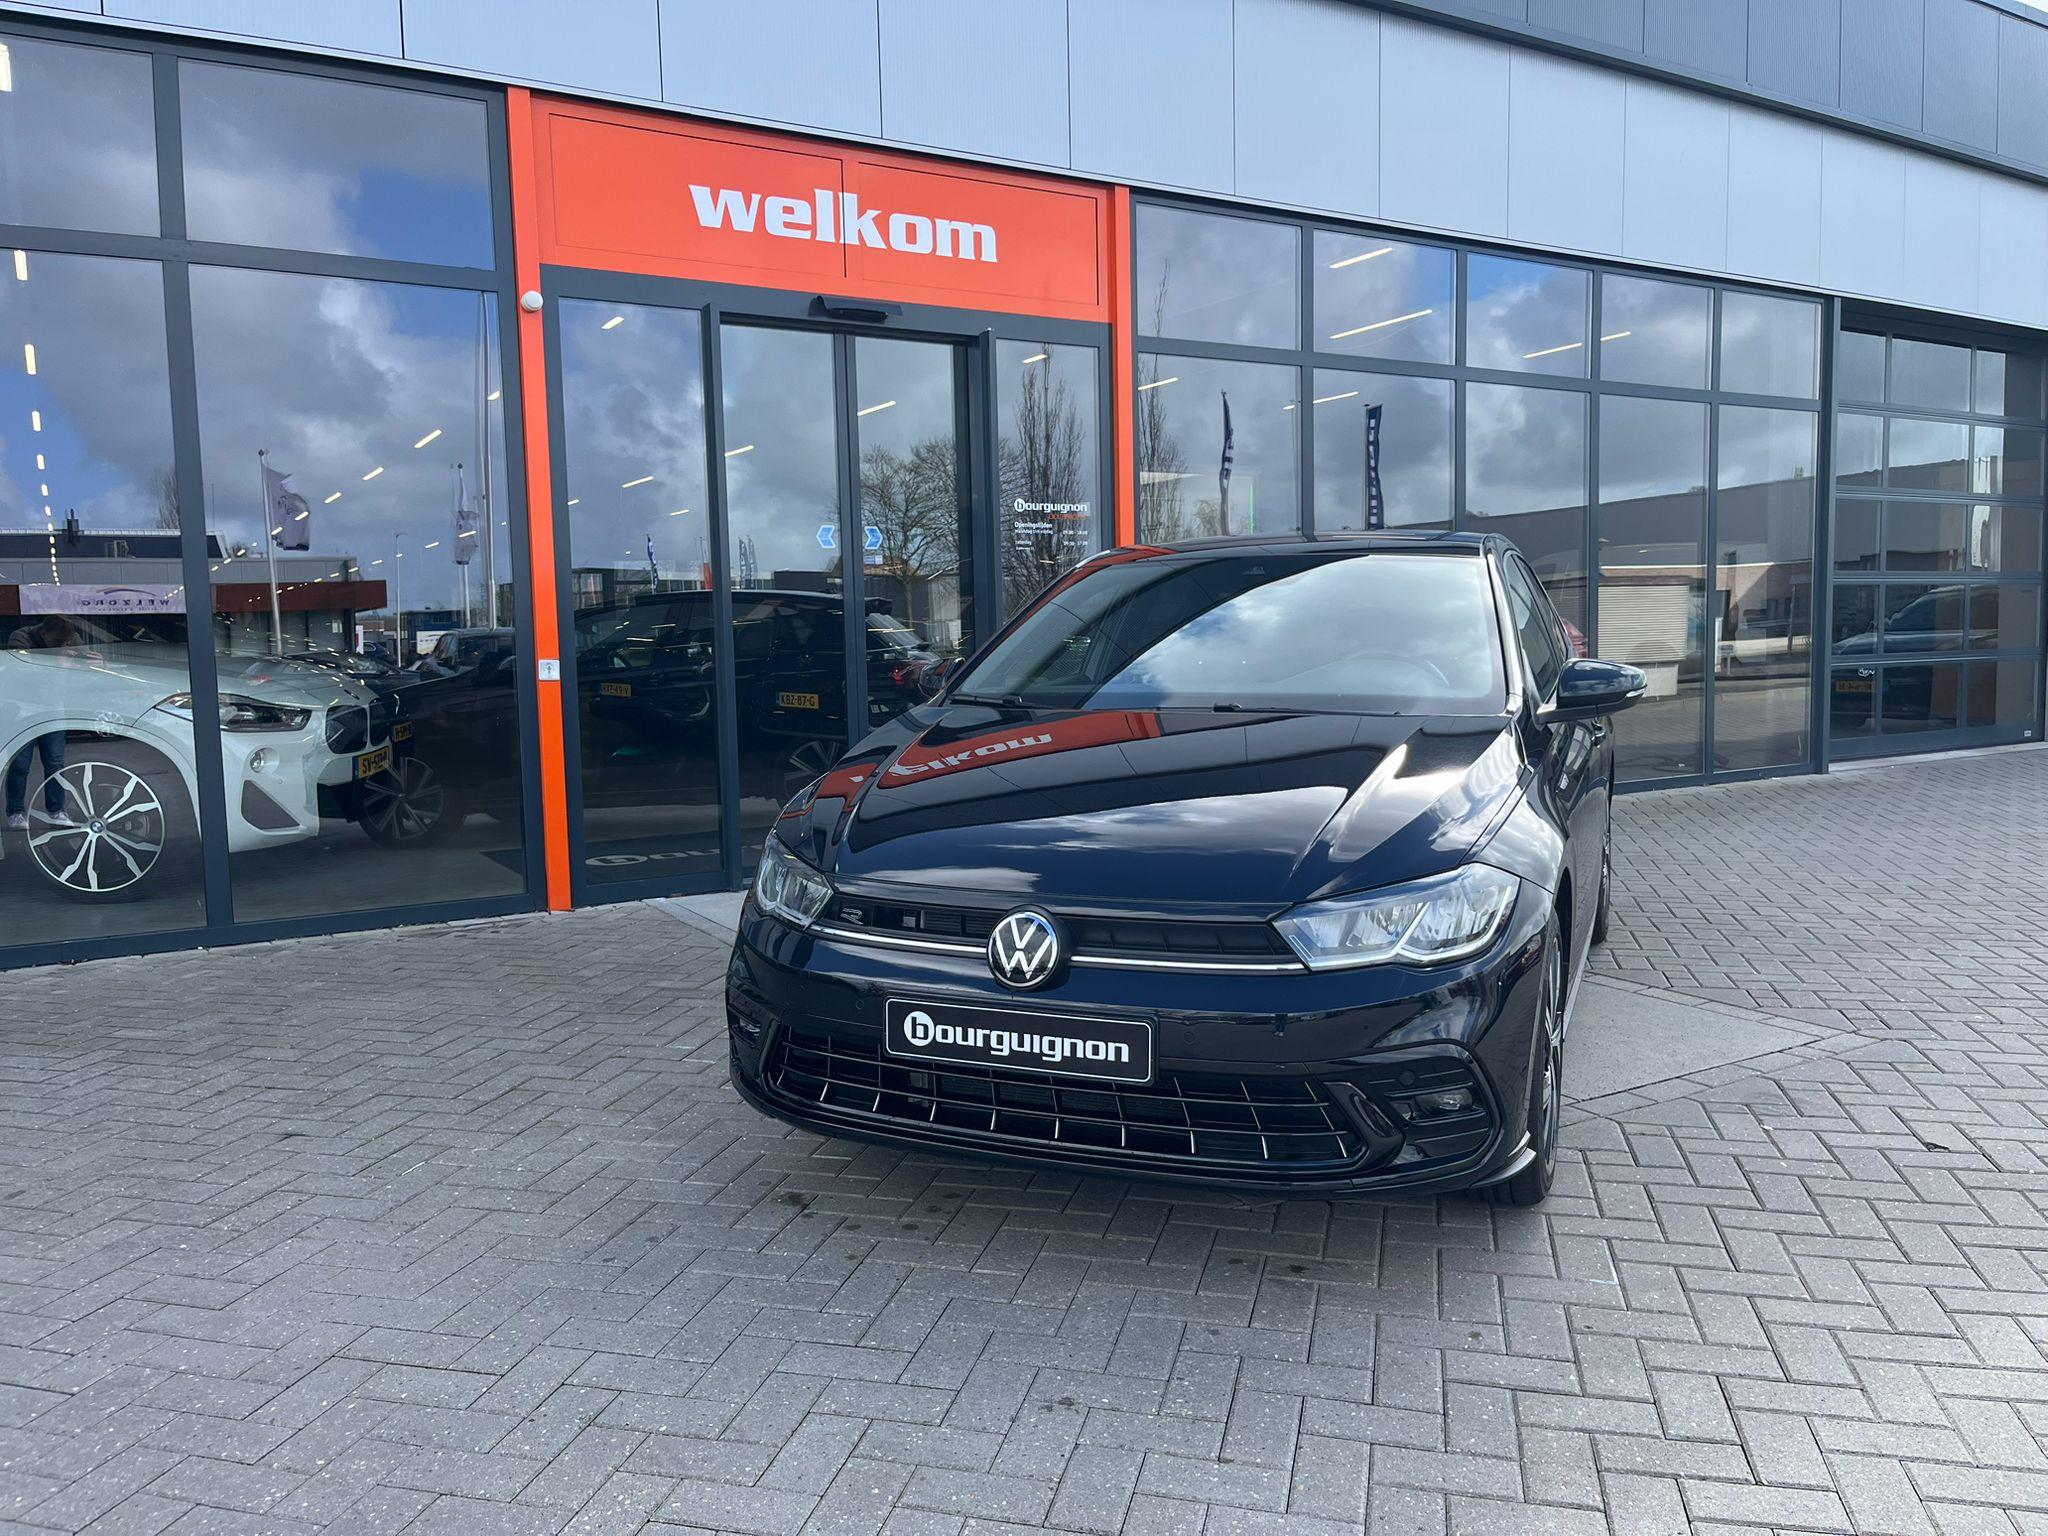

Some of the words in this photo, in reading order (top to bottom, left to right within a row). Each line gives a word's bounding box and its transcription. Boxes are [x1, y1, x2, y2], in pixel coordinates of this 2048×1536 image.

[687, 184, 998, 263] welkom
[1014, 498, 1088, 513] bourguignon
[780, 692, 816, 707] KBZ-87-G
[903, 1010, 1130, 1063] bourguignon
